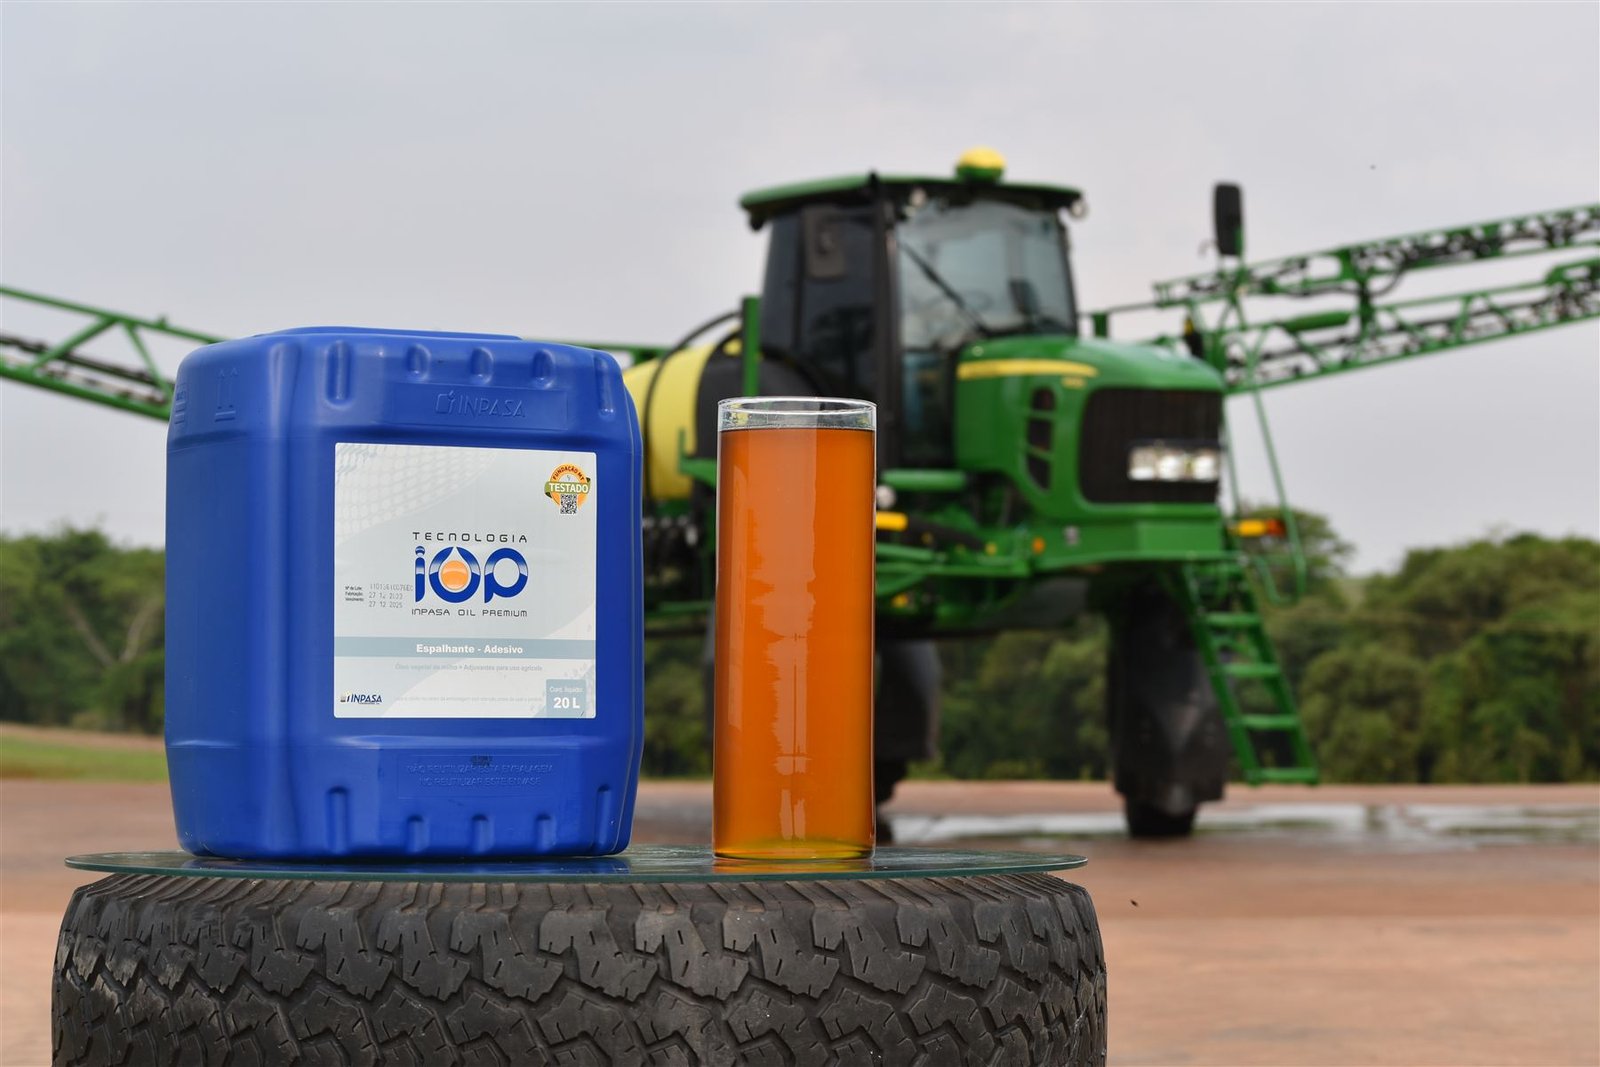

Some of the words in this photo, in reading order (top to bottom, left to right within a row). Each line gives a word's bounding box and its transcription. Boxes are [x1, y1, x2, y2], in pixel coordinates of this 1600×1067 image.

[459, 394, 526, 417] INPASA
[549, 482, 589, 493] TESTADO
[412, 531, 528, 543] TECNOLOGIA
[411, 608, 450, 616] INPASA
[457, 608, 476, 617] OIL
[482, 609, 528, 618] PREMIUM
[416, 643, 475, 655] Espalhante
[483, 644, 523, 654] Adesivo
[350, 693, 382, 704] INPASA
[553, 697, 569, 709] 20
[572, 697, 580, 709] L
